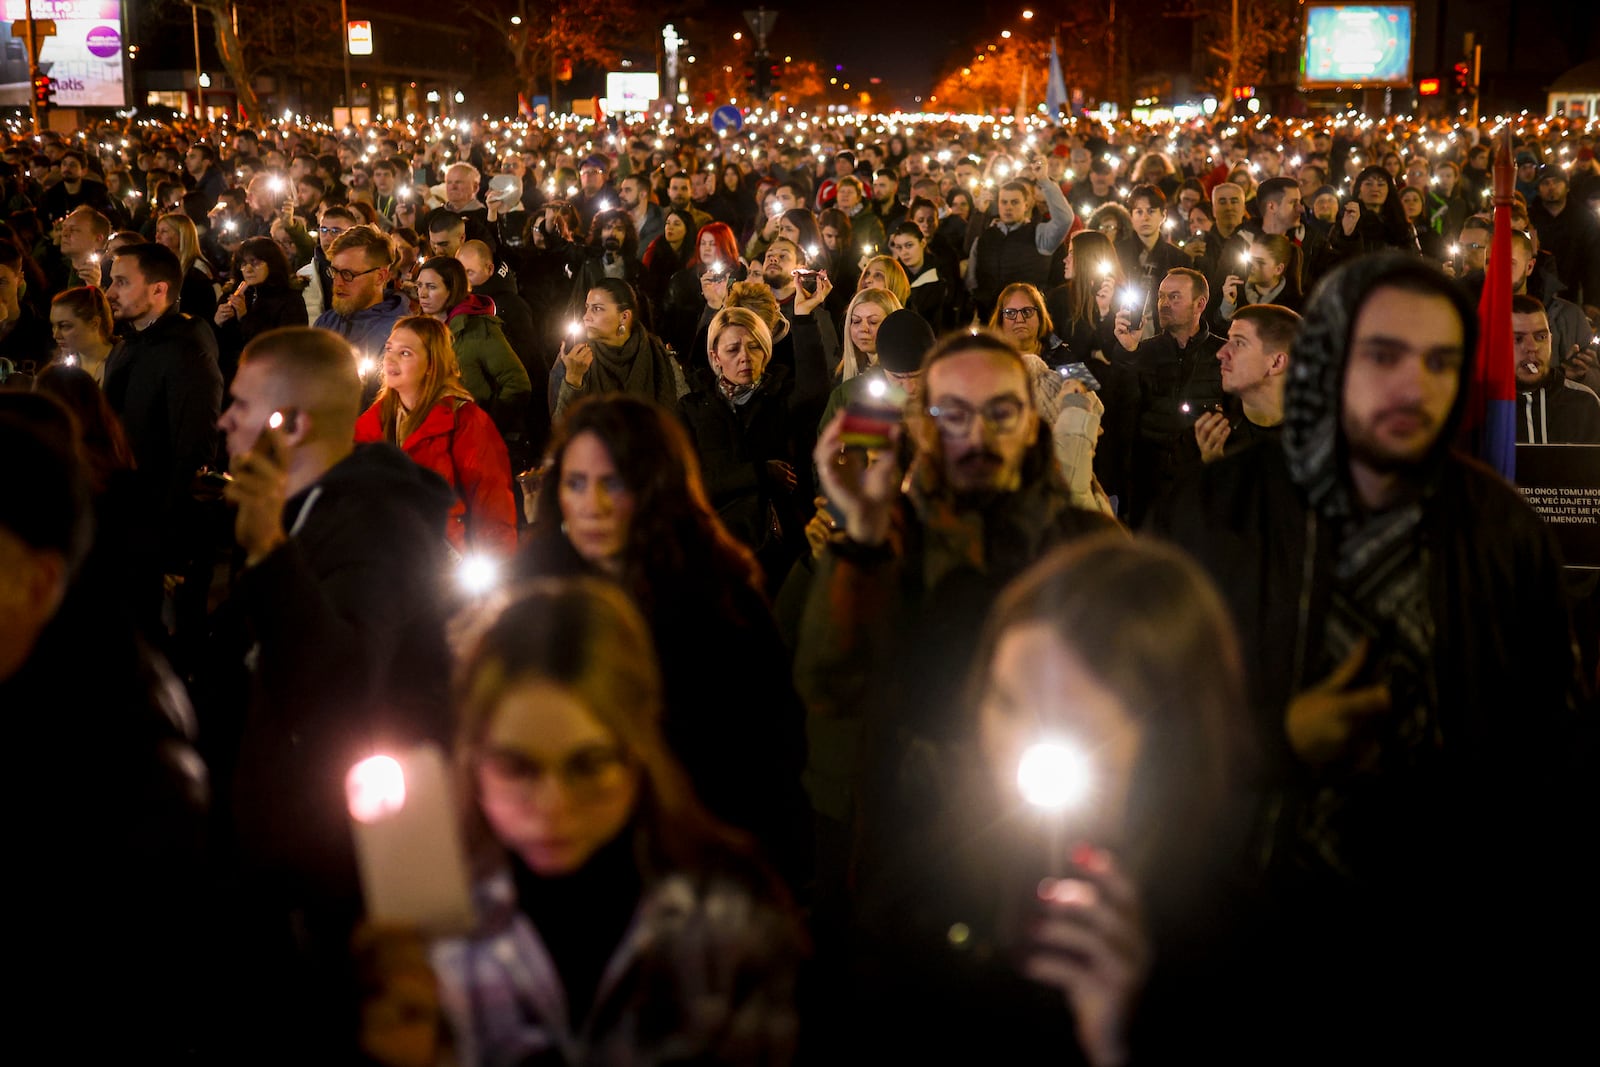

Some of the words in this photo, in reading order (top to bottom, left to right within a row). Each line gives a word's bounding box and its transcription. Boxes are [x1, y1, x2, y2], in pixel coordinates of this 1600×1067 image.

[1559, 488, 1583, 496] TOMU
[1542, 496, 1559, 504] VEĆ
[1560, 497, 1591, 505] DAJETE
[1535, 506, 1576, 514] OMILUJTE
[1577, 507, 1590, 515] ME
[1550, 516, 1597, 524] IMENOVATI.
